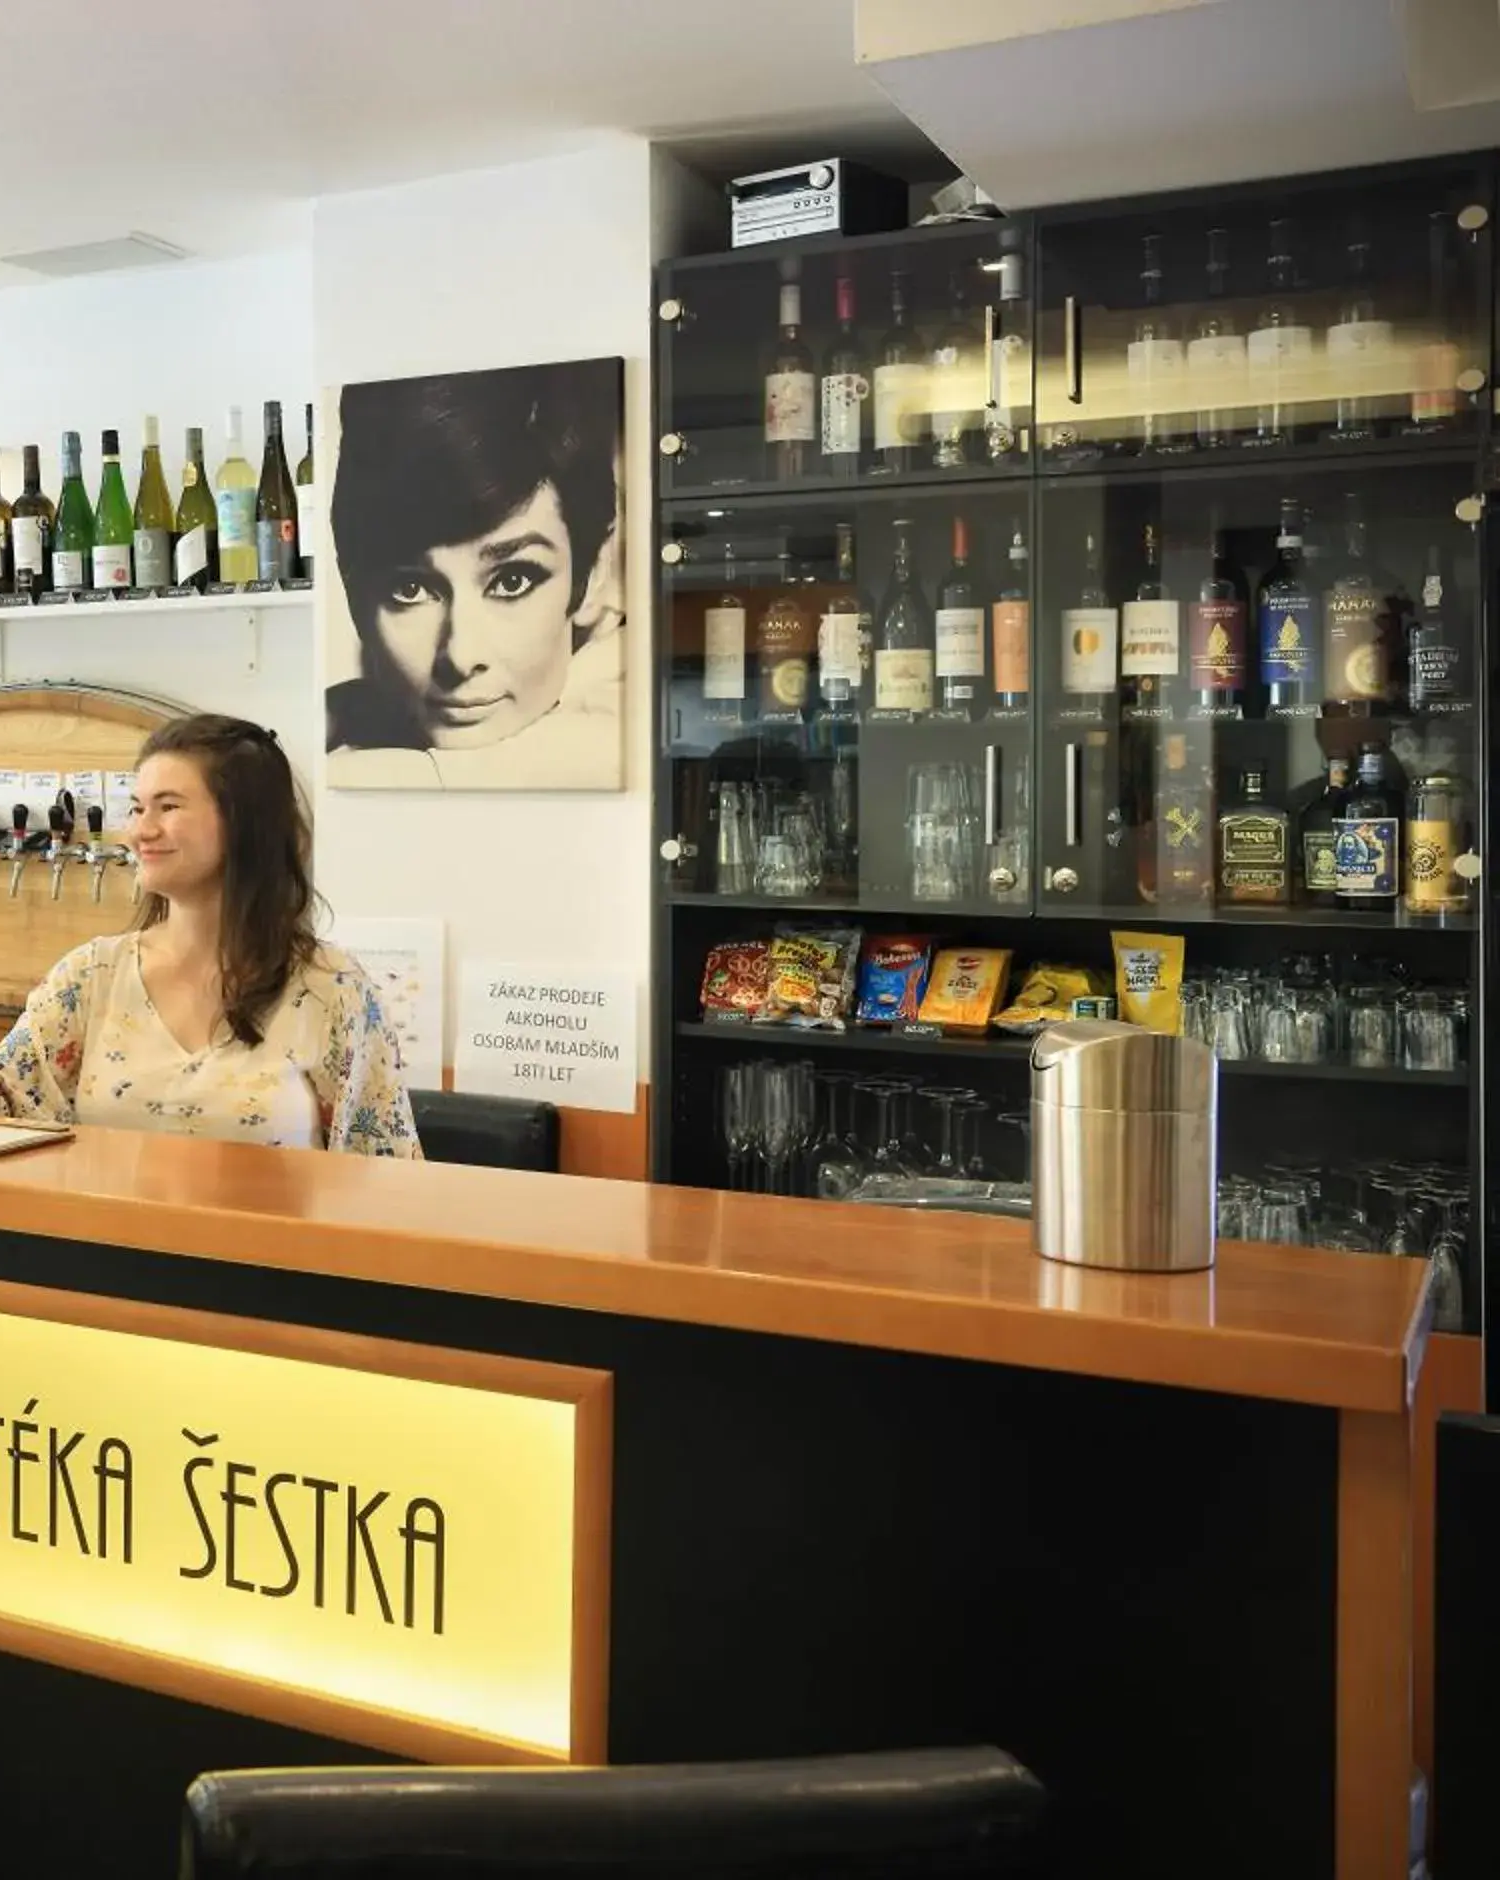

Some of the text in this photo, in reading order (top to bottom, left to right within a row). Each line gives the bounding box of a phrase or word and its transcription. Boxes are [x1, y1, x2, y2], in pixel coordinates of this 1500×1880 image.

[488, 980, 606, 1007] ZÁKAZ PRODEJE
[505, 1010, 588, 1031] ALKOHOLU
[544, 1038, 620, 1061] MLADŠÍM
[549, 1066, 577, 1083] LET
[179, 1427, 445, 1635] ŠESTKA
